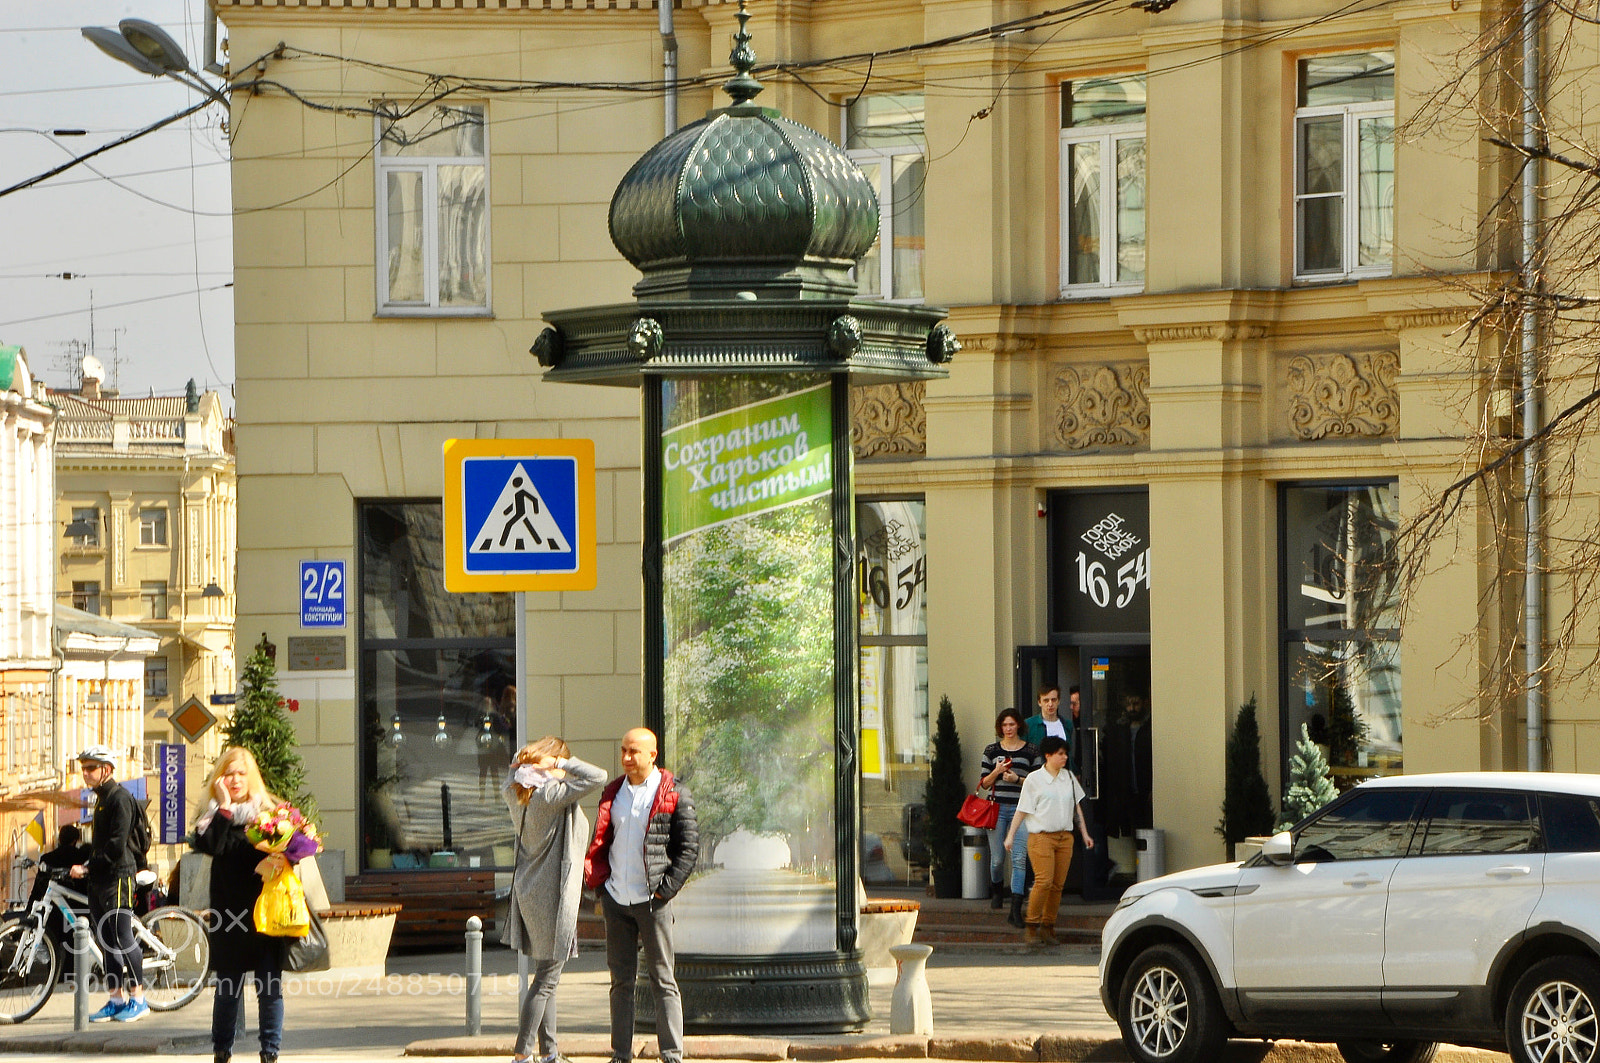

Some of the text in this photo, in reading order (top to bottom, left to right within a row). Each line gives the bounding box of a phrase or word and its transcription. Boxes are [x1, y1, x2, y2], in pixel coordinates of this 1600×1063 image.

[664, 412, 800, 471] Сохраним
[687, 431, 809, 493] Харьков
[710, 452, 831, 511] чистым!
[1080, 513, 1125, 544] ГОРОД
[1093, 524, 1127, 552] СКОЕ
[1104, 532, 1141, 560] КАФЕ
[304, 564, 342, 604] 2/2
[1075, 547, 1150, 609] 16 54
[166, 746, 178, 831] MEGASPORT
